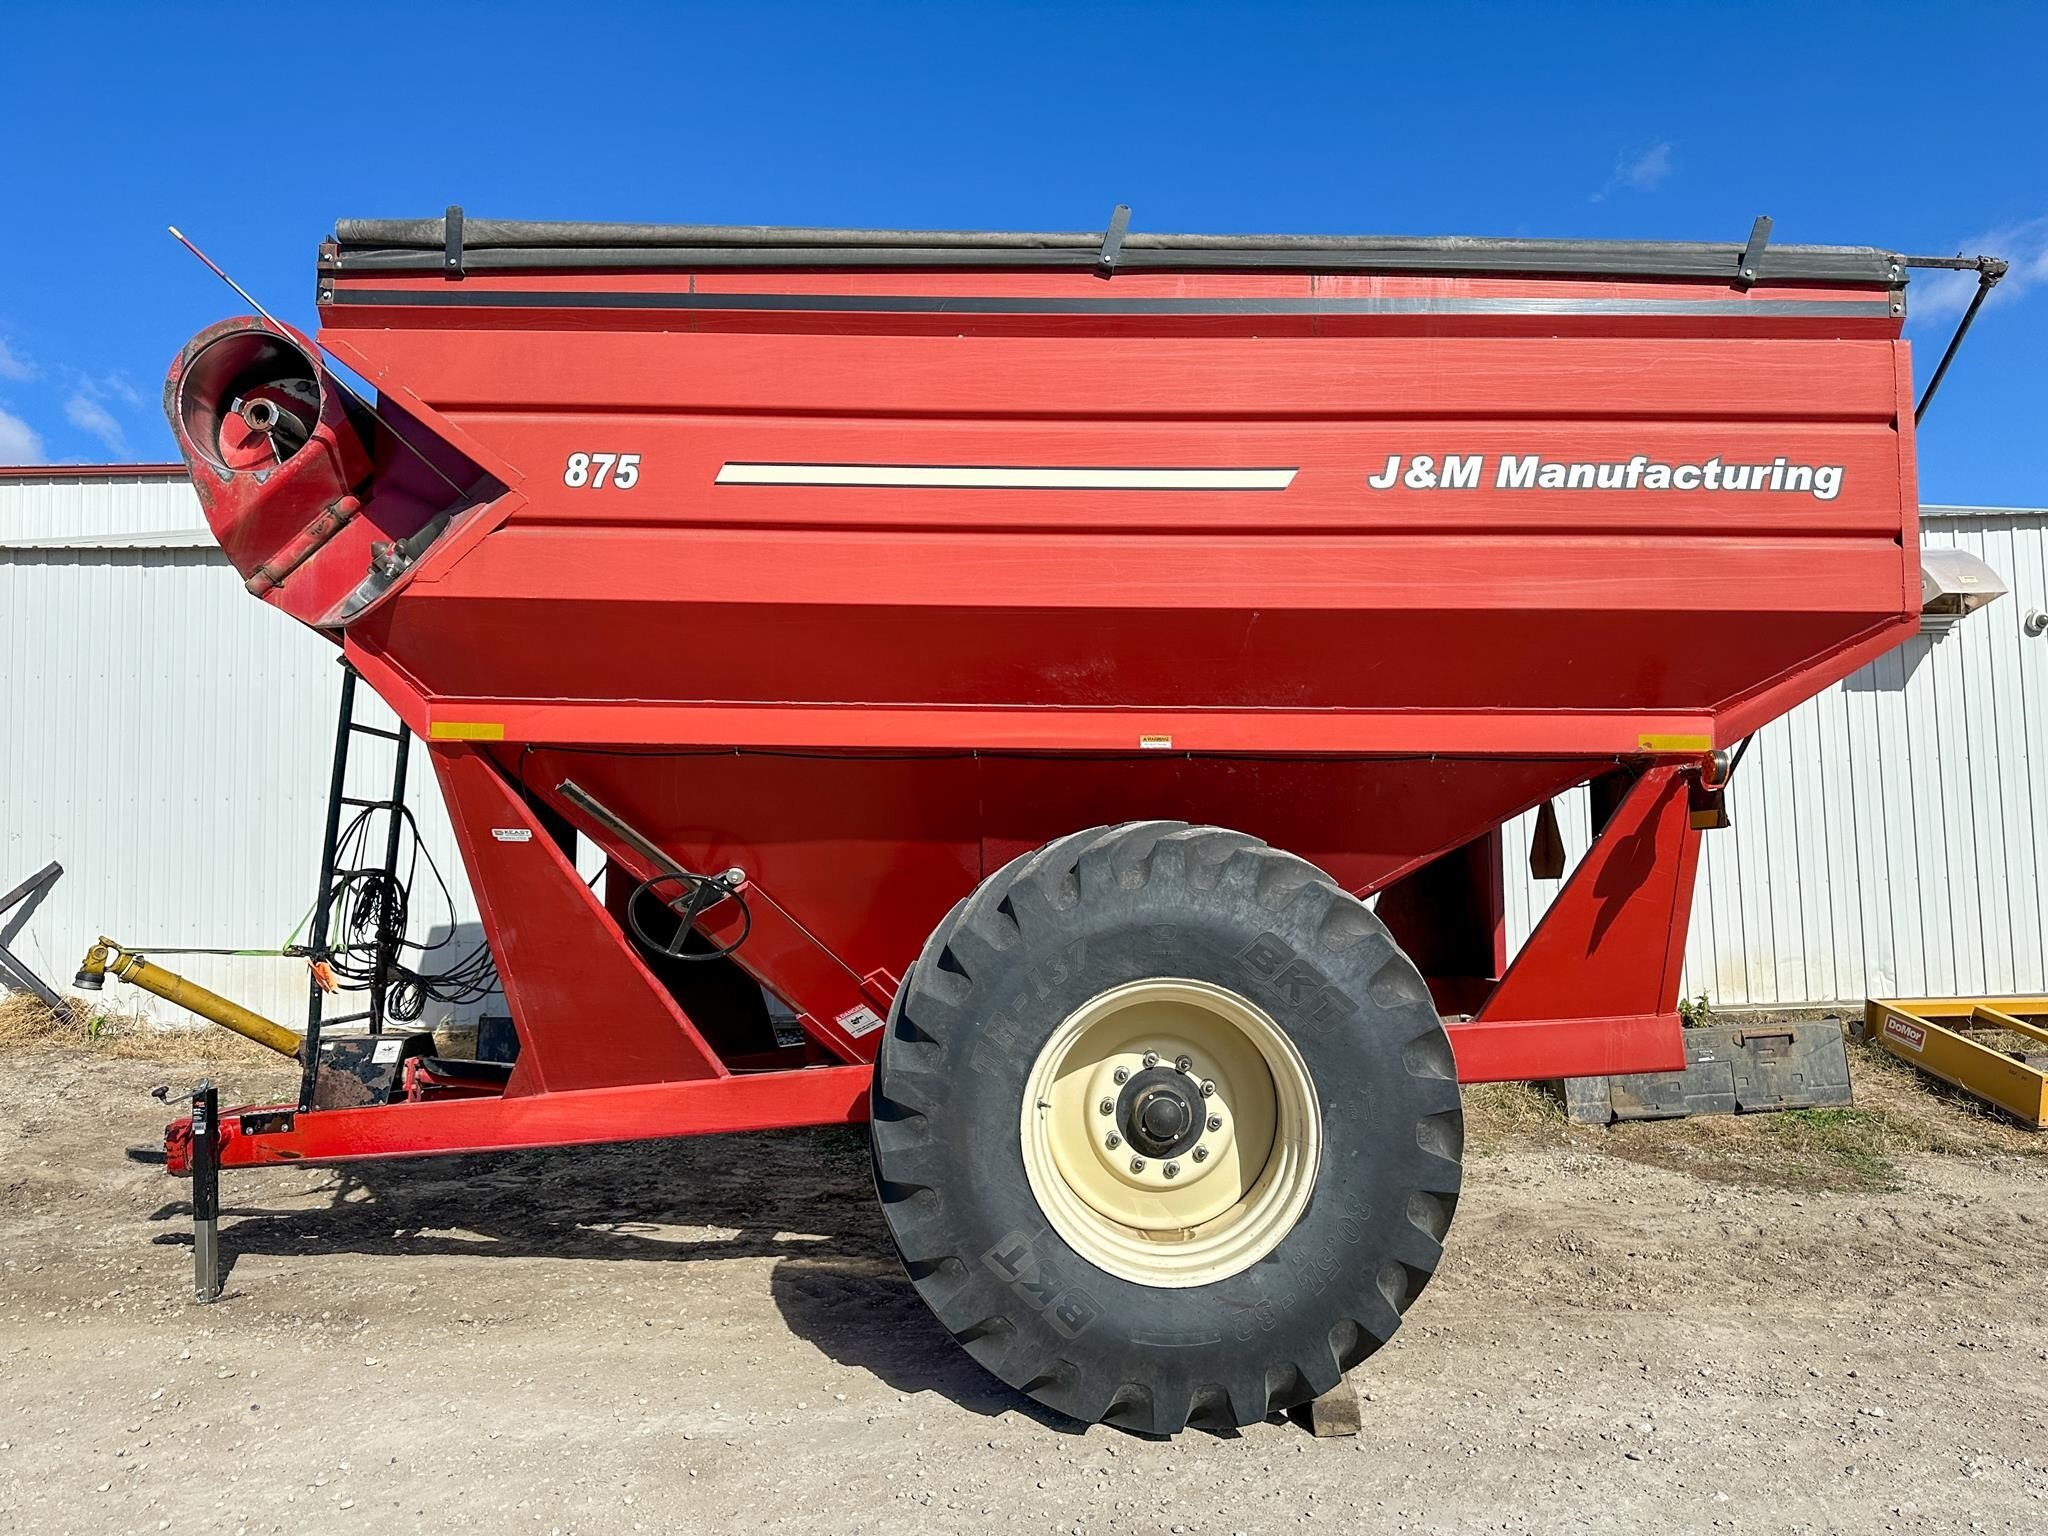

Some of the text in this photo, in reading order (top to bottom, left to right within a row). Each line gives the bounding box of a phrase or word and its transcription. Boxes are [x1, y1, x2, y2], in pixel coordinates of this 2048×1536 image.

[563, 452, 642, 490] 875
[1367, 454, 1844, 500] J&M Manufacturing
[1232, 931, 1361, 1034] BKT
[1888, 1018, 1922, 1041] DoMor
[979, 1230, 1106, 1340] BKT
